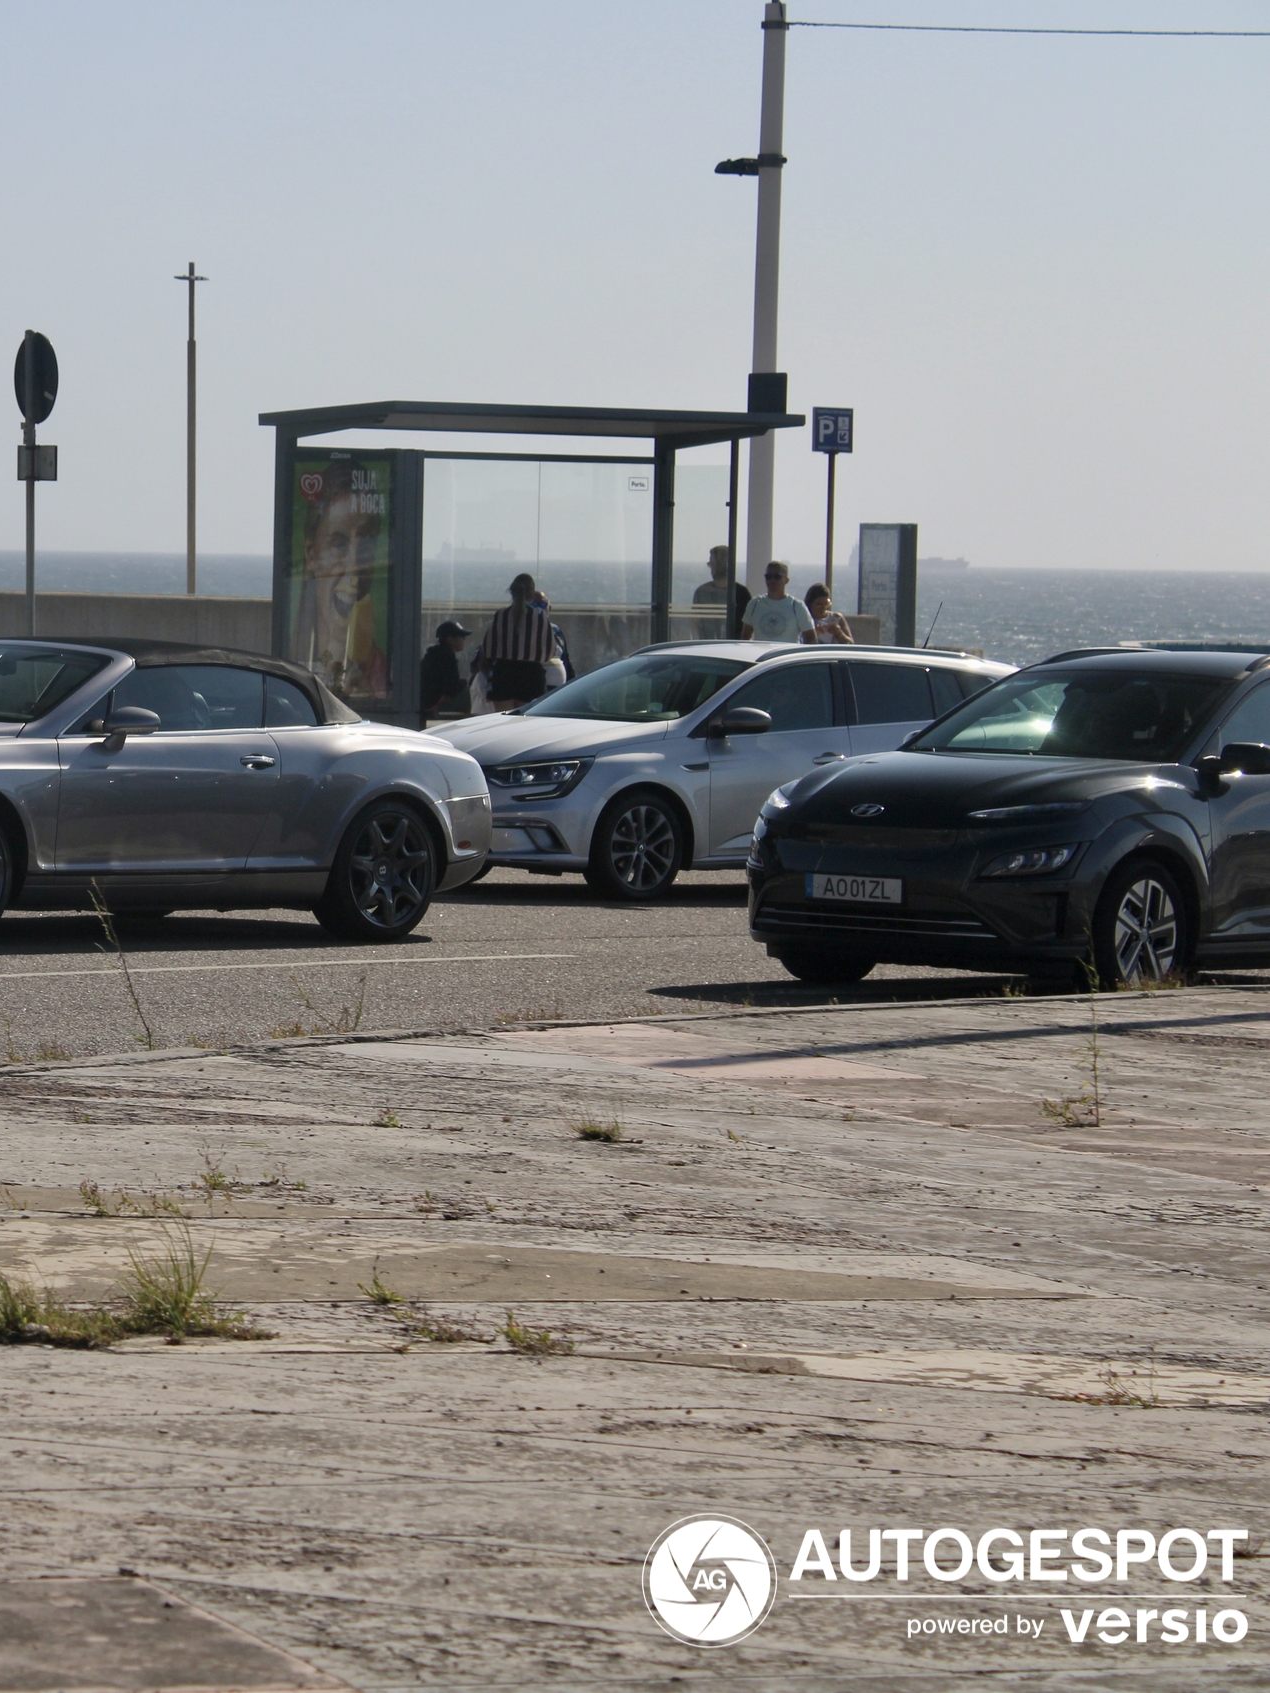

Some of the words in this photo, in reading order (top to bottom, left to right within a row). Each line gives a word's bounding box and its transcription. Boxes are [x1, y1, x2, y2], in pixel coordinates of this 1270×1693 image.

[819, 419, 834, 443] P
[352, 470, 377, 490] SUJA
[351, 494, 358, 514] A
[360, 494, 386, 514] BOCA
